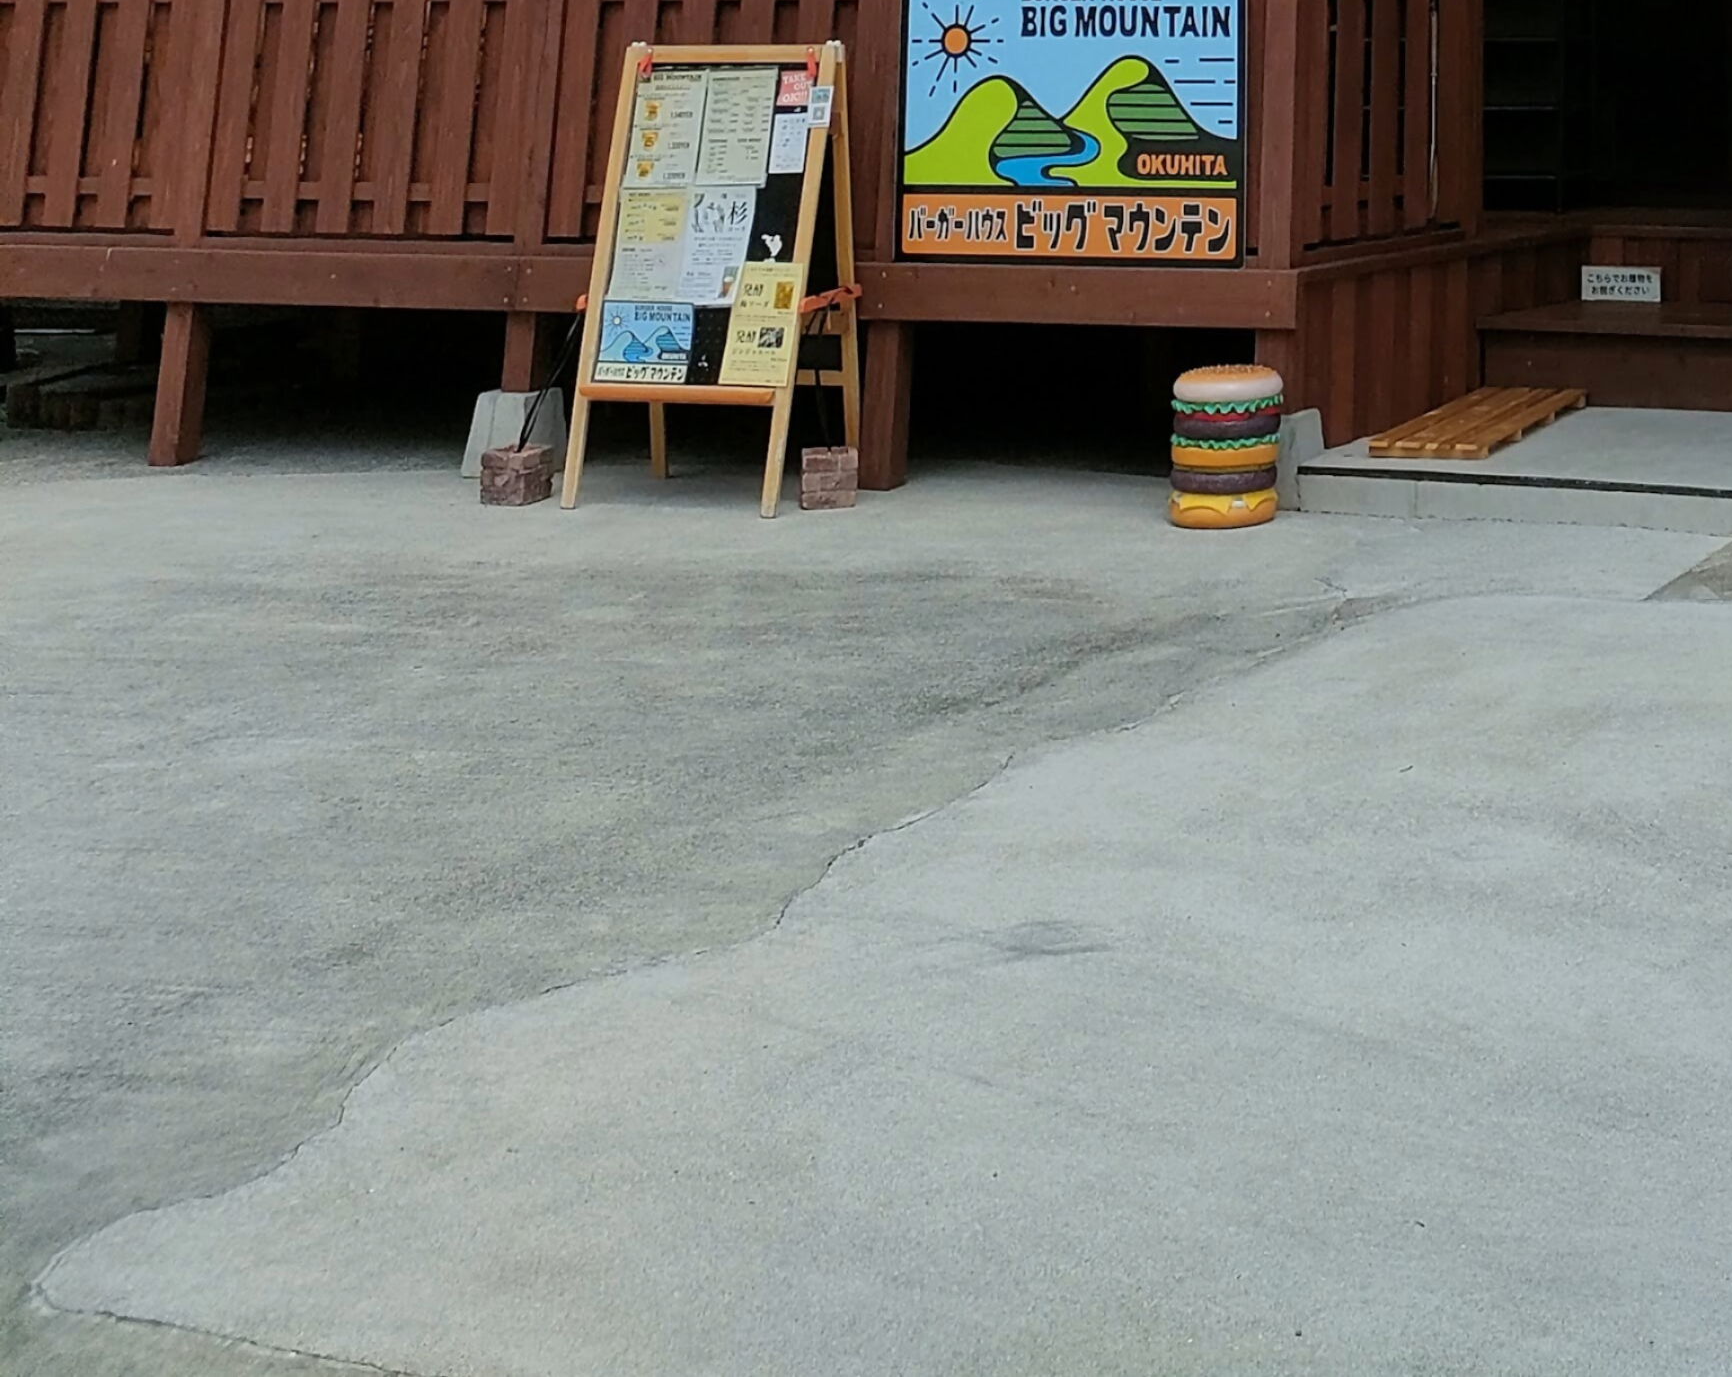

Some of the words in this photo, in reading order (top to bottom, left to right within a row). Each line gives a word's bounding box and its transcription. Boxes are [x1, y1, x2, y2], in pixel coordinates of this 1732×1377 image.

[1021, 6, 1067, 37] BIG
[1075, 6, 1231, 38] MOUNTAIN
[782, 71, 807, 85] TAKE
[794, 80, 814, 91] OUT
[1137, 154, 1228, 176] OKUHITA
[728, 200, 748, 225] 杉
[908, 207, 1008, 241] バーガーハウス
[1015, 200, 1097, 251] ビッグ
[1103, 202, 1231, 253] マウンテン
[1586, 273, 1653, 284] こちらでお履物を
[1591, 286, 1651, 296] お脱ぎください
[634, 311, 648, 322] BIG
[649, 312, 691, 322] MOUNTAIN
